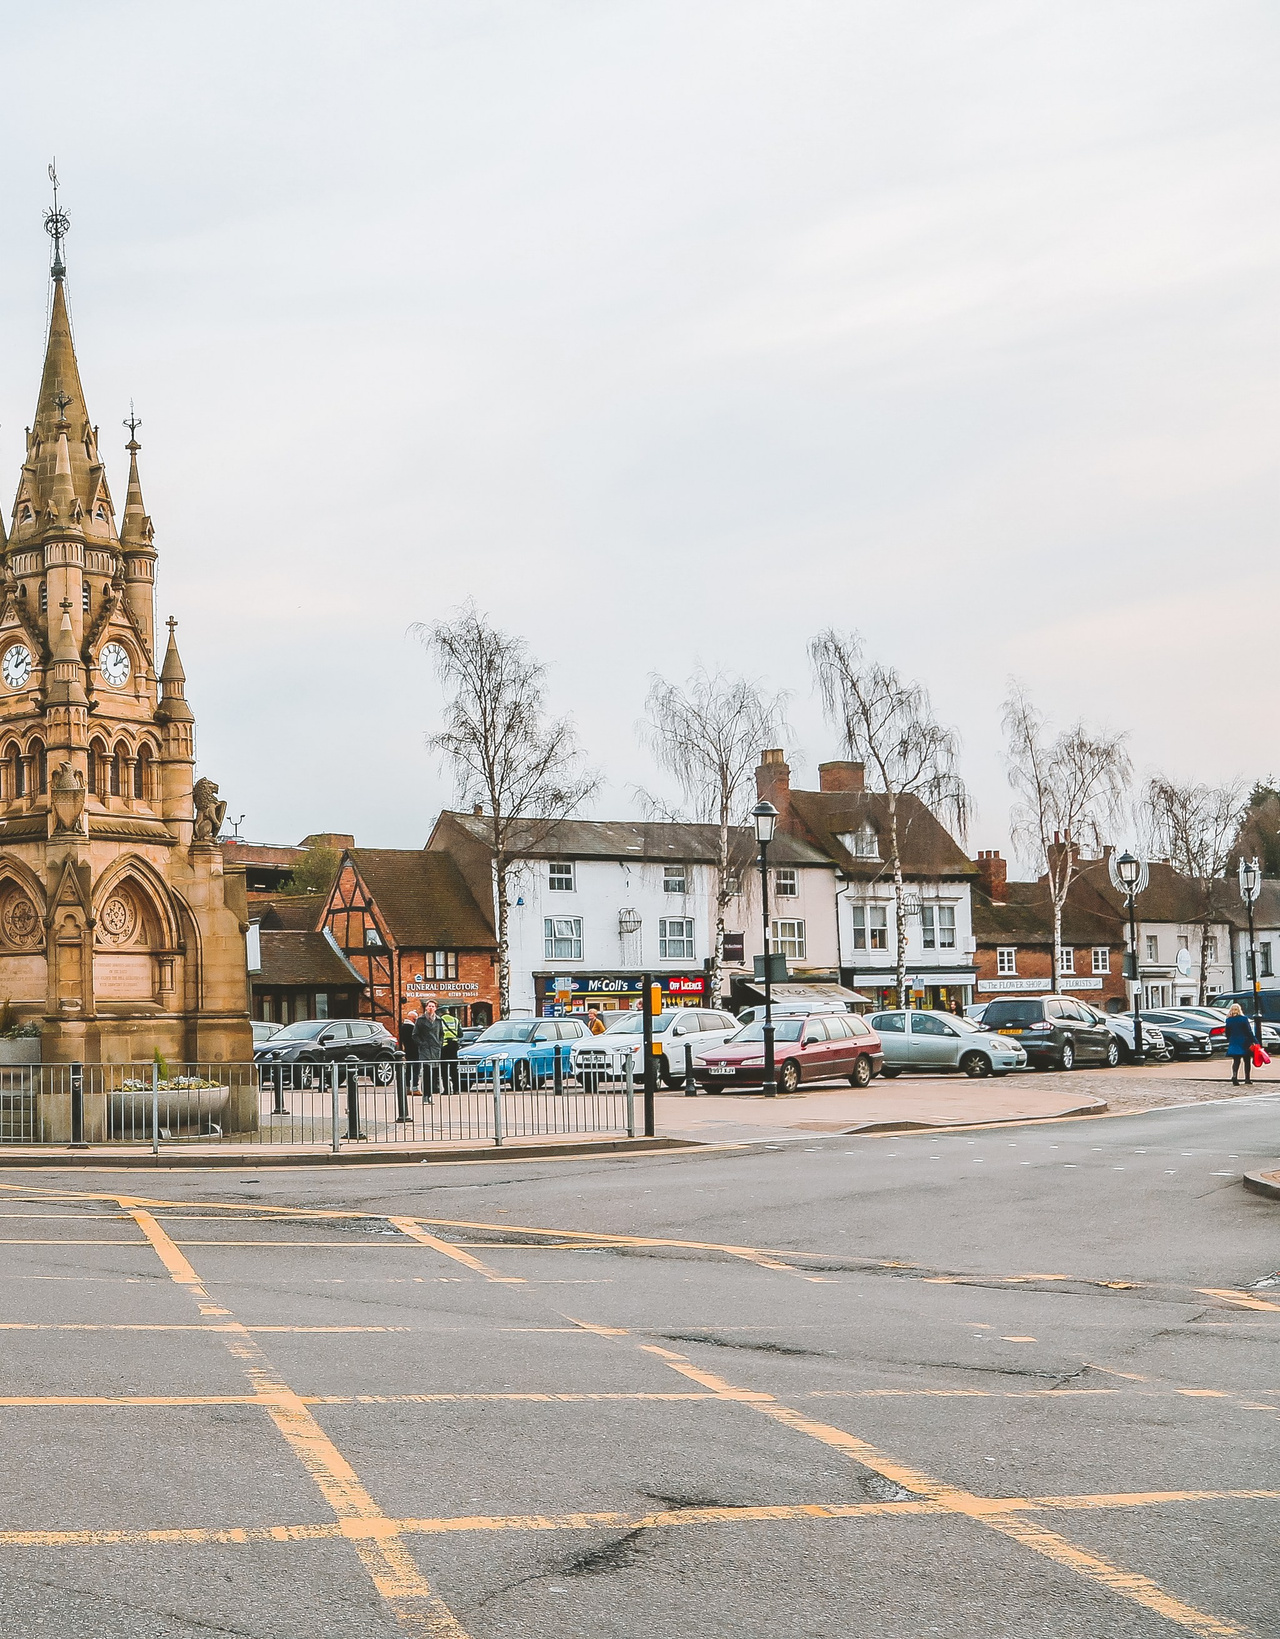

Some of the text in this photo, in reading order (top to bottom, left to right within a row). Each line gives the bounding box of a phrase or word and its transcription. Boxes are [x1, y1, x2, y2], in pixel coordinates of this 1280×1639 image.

[588, 980, 629, 991] McColl's
[999, 980, 1024, 989] FLOWER
[1026, 980, 1043, 988] SHOP
[1065, 979, 1092, 987] FLORISTS
